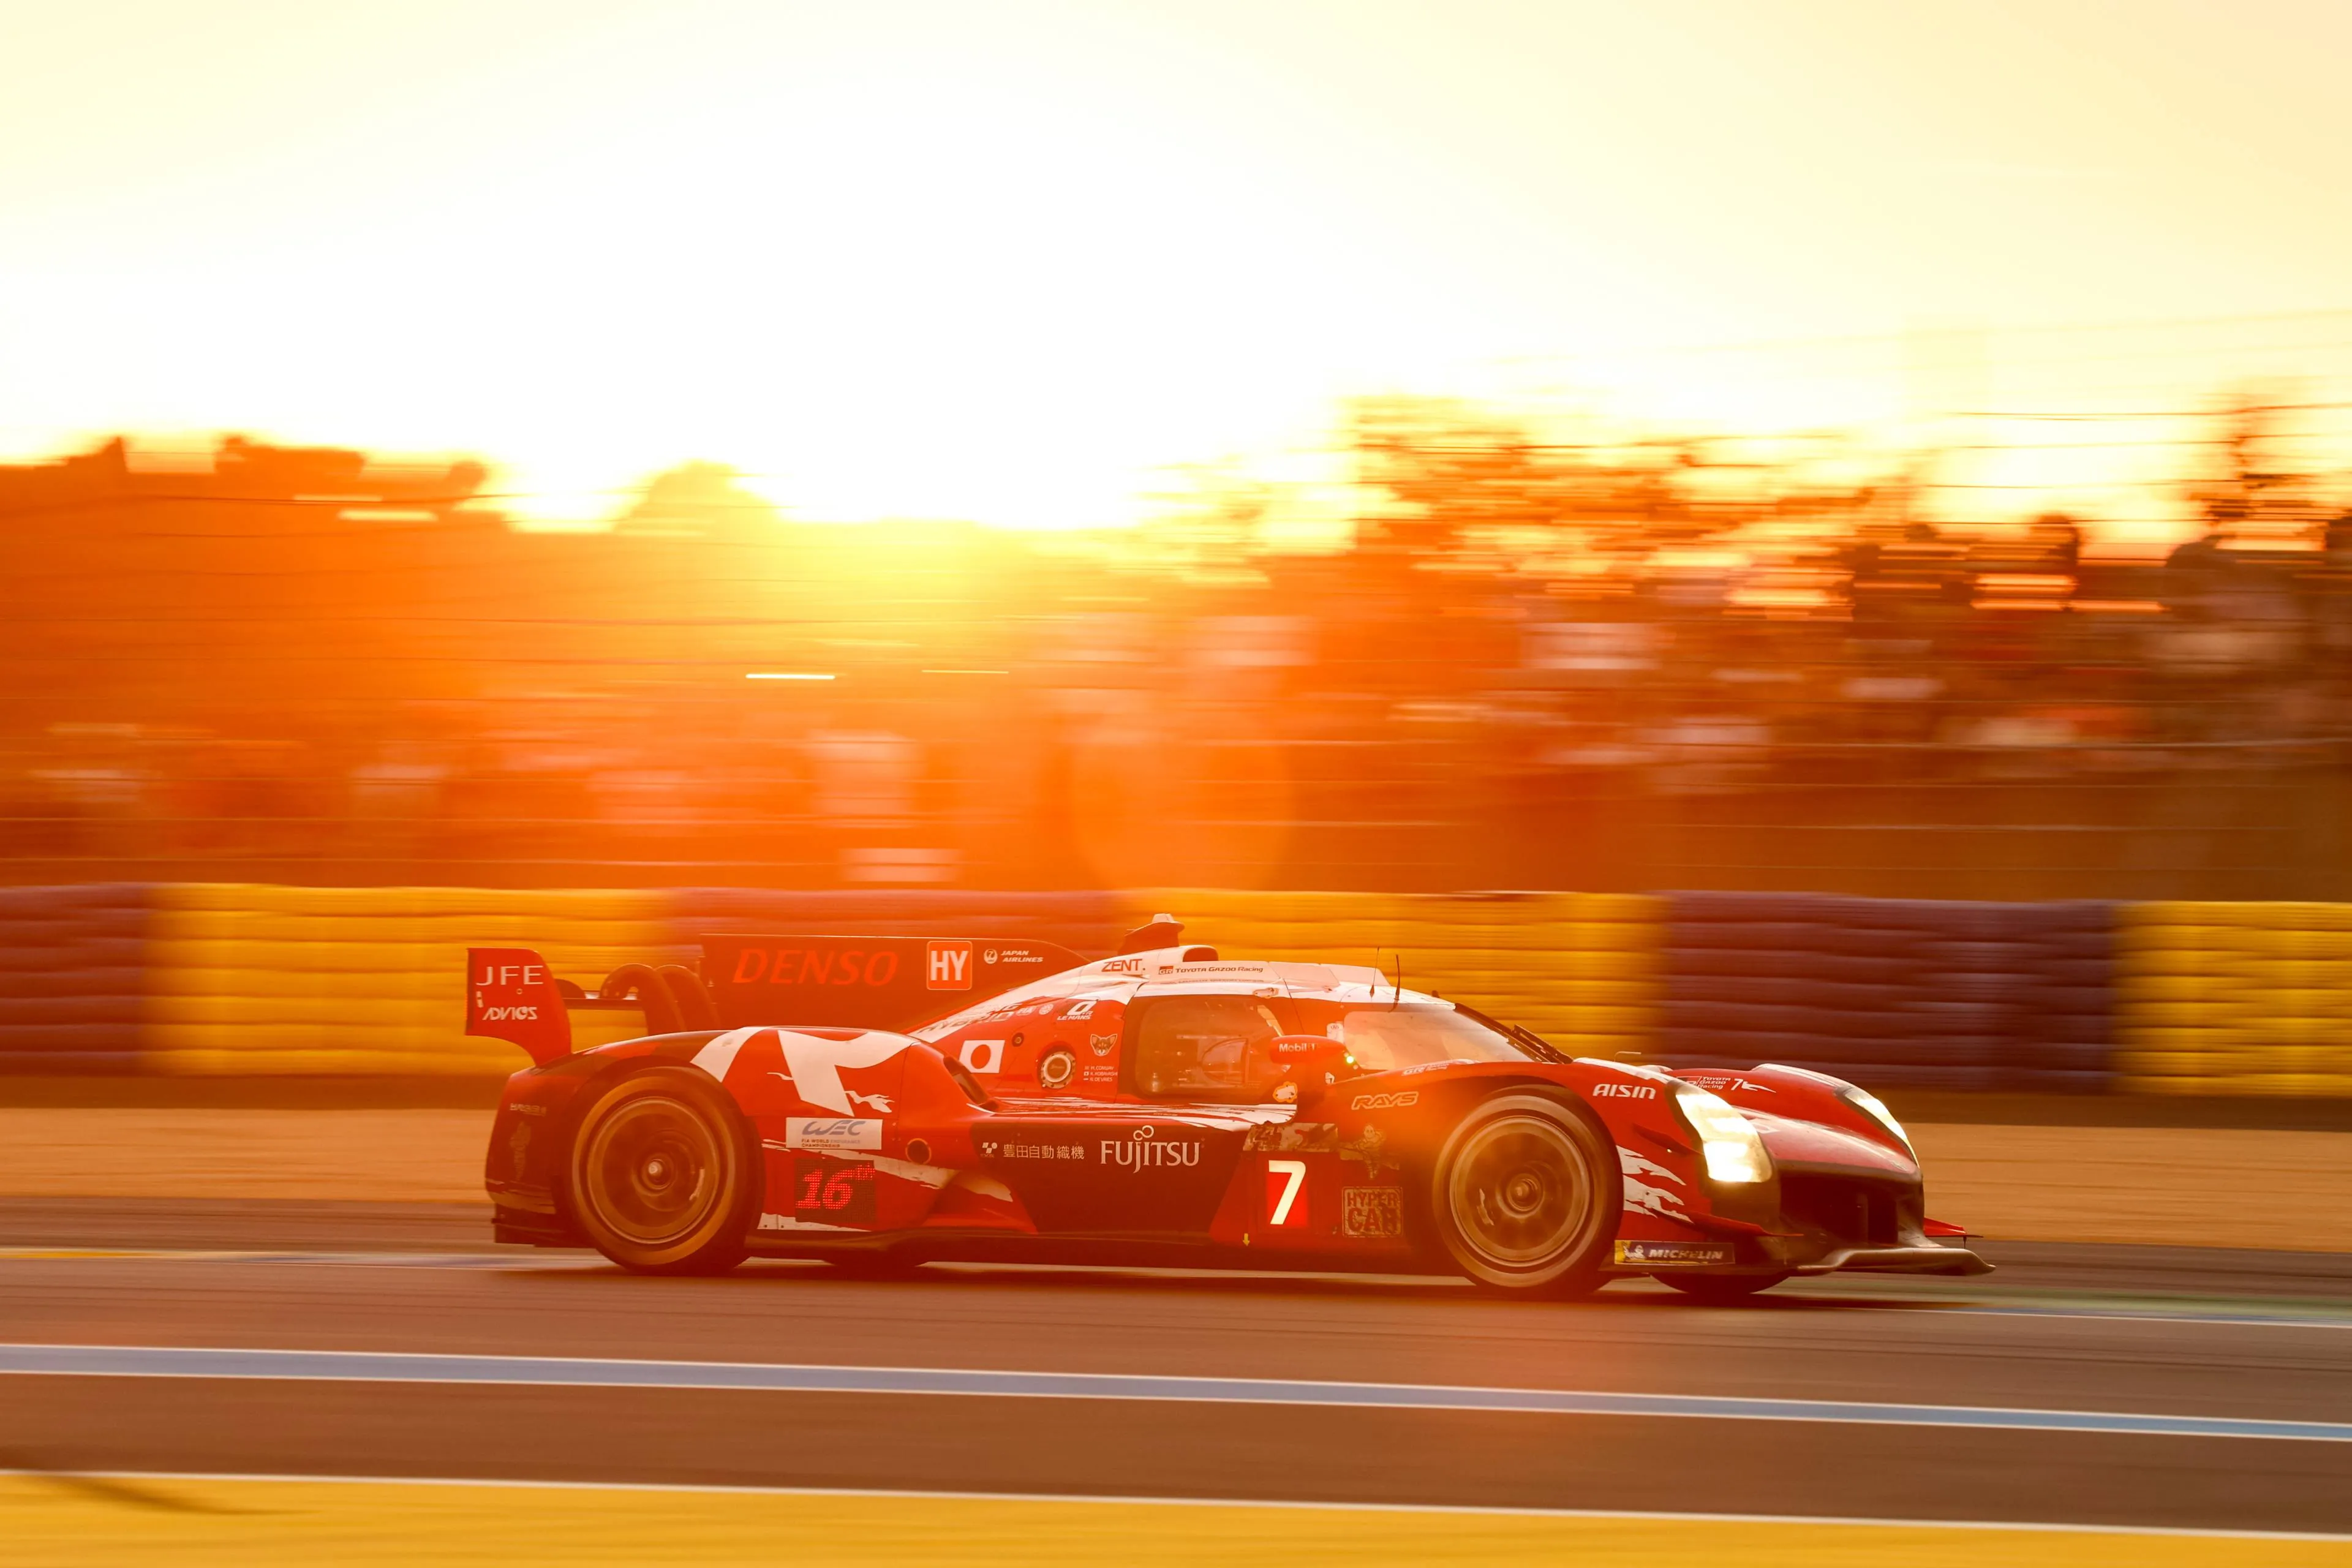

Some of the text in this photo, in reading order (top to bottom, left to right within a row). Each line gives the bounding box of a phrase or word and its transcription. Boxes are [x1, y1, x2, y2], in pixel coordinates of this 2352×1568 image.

[476, 965, 543, 986] JFE
[733, 949, 899, 986] DENSO
[930, 951, 968, 981] HY
[1279, 1043, 1307, 1052] Mobil
[1593, 1084, 1656, 1099] AISIN
[1731, 1079, 1744, 1091] 7
[1351, 1091, 1419, 1110] RAYS
[802, 1120, 865, 1136] WEC
[1101, 1137, 1200, 1174] FUJITSU
[1268, 1160, 1306, 1224] 7
[1348, 1192, 1396, 1207] HYPER
